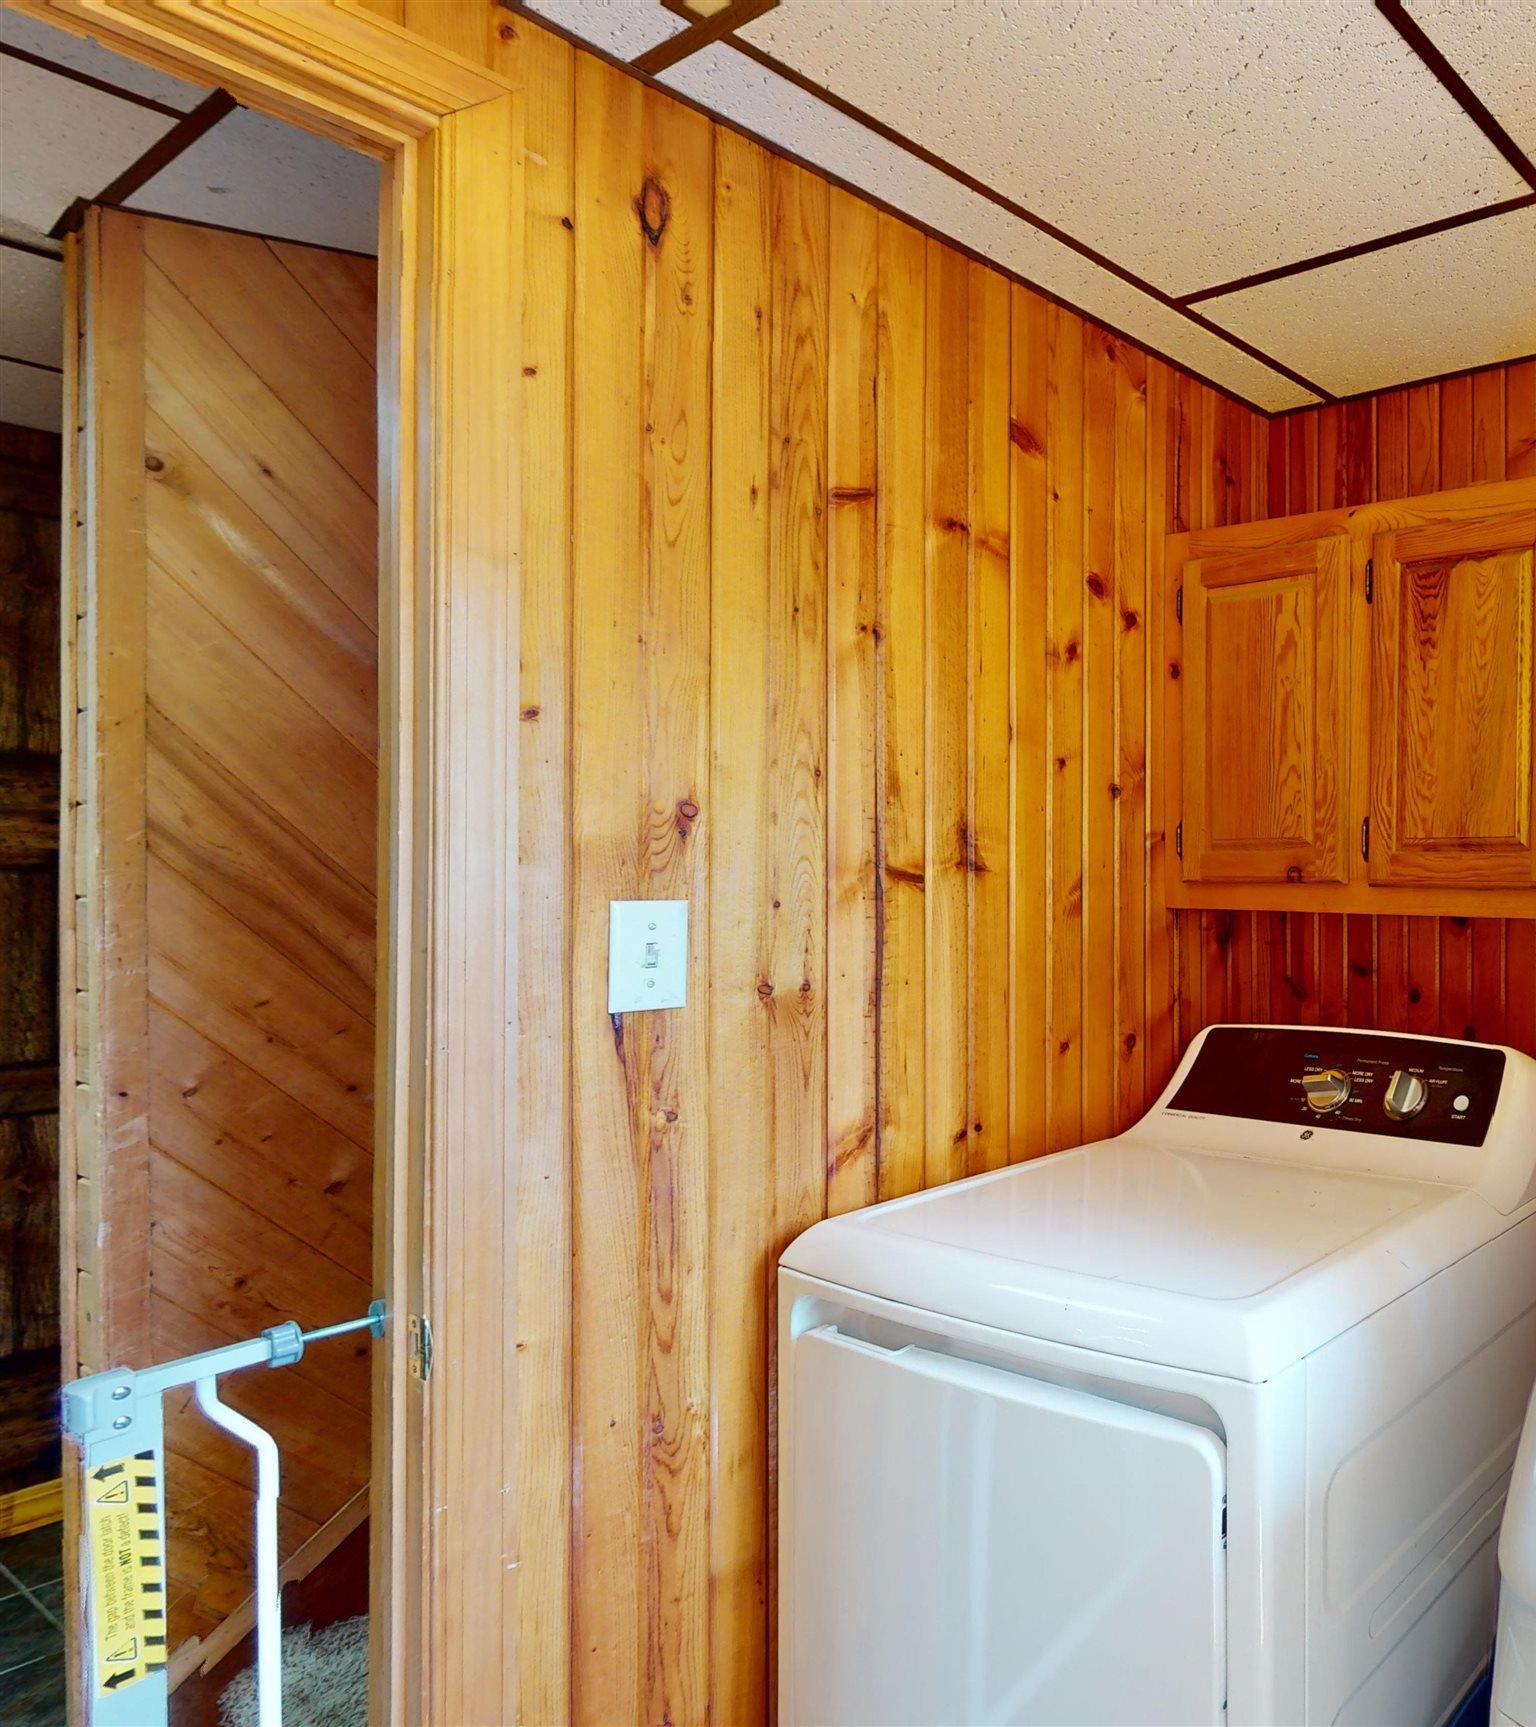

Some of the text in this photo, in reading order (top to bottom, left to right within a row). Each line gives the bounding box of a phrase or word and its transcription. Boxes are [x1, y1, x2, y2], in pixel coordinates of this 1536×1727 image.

[100, 1514, 112, 1537] latch
[101, 1538, 113, 1558] door
[119, 1547, 131, 1567] NOT
[102, 1558, 114, 1572] the
[104, 1572, 117, 1607] between
[105, 1624, 119, 1641] The
